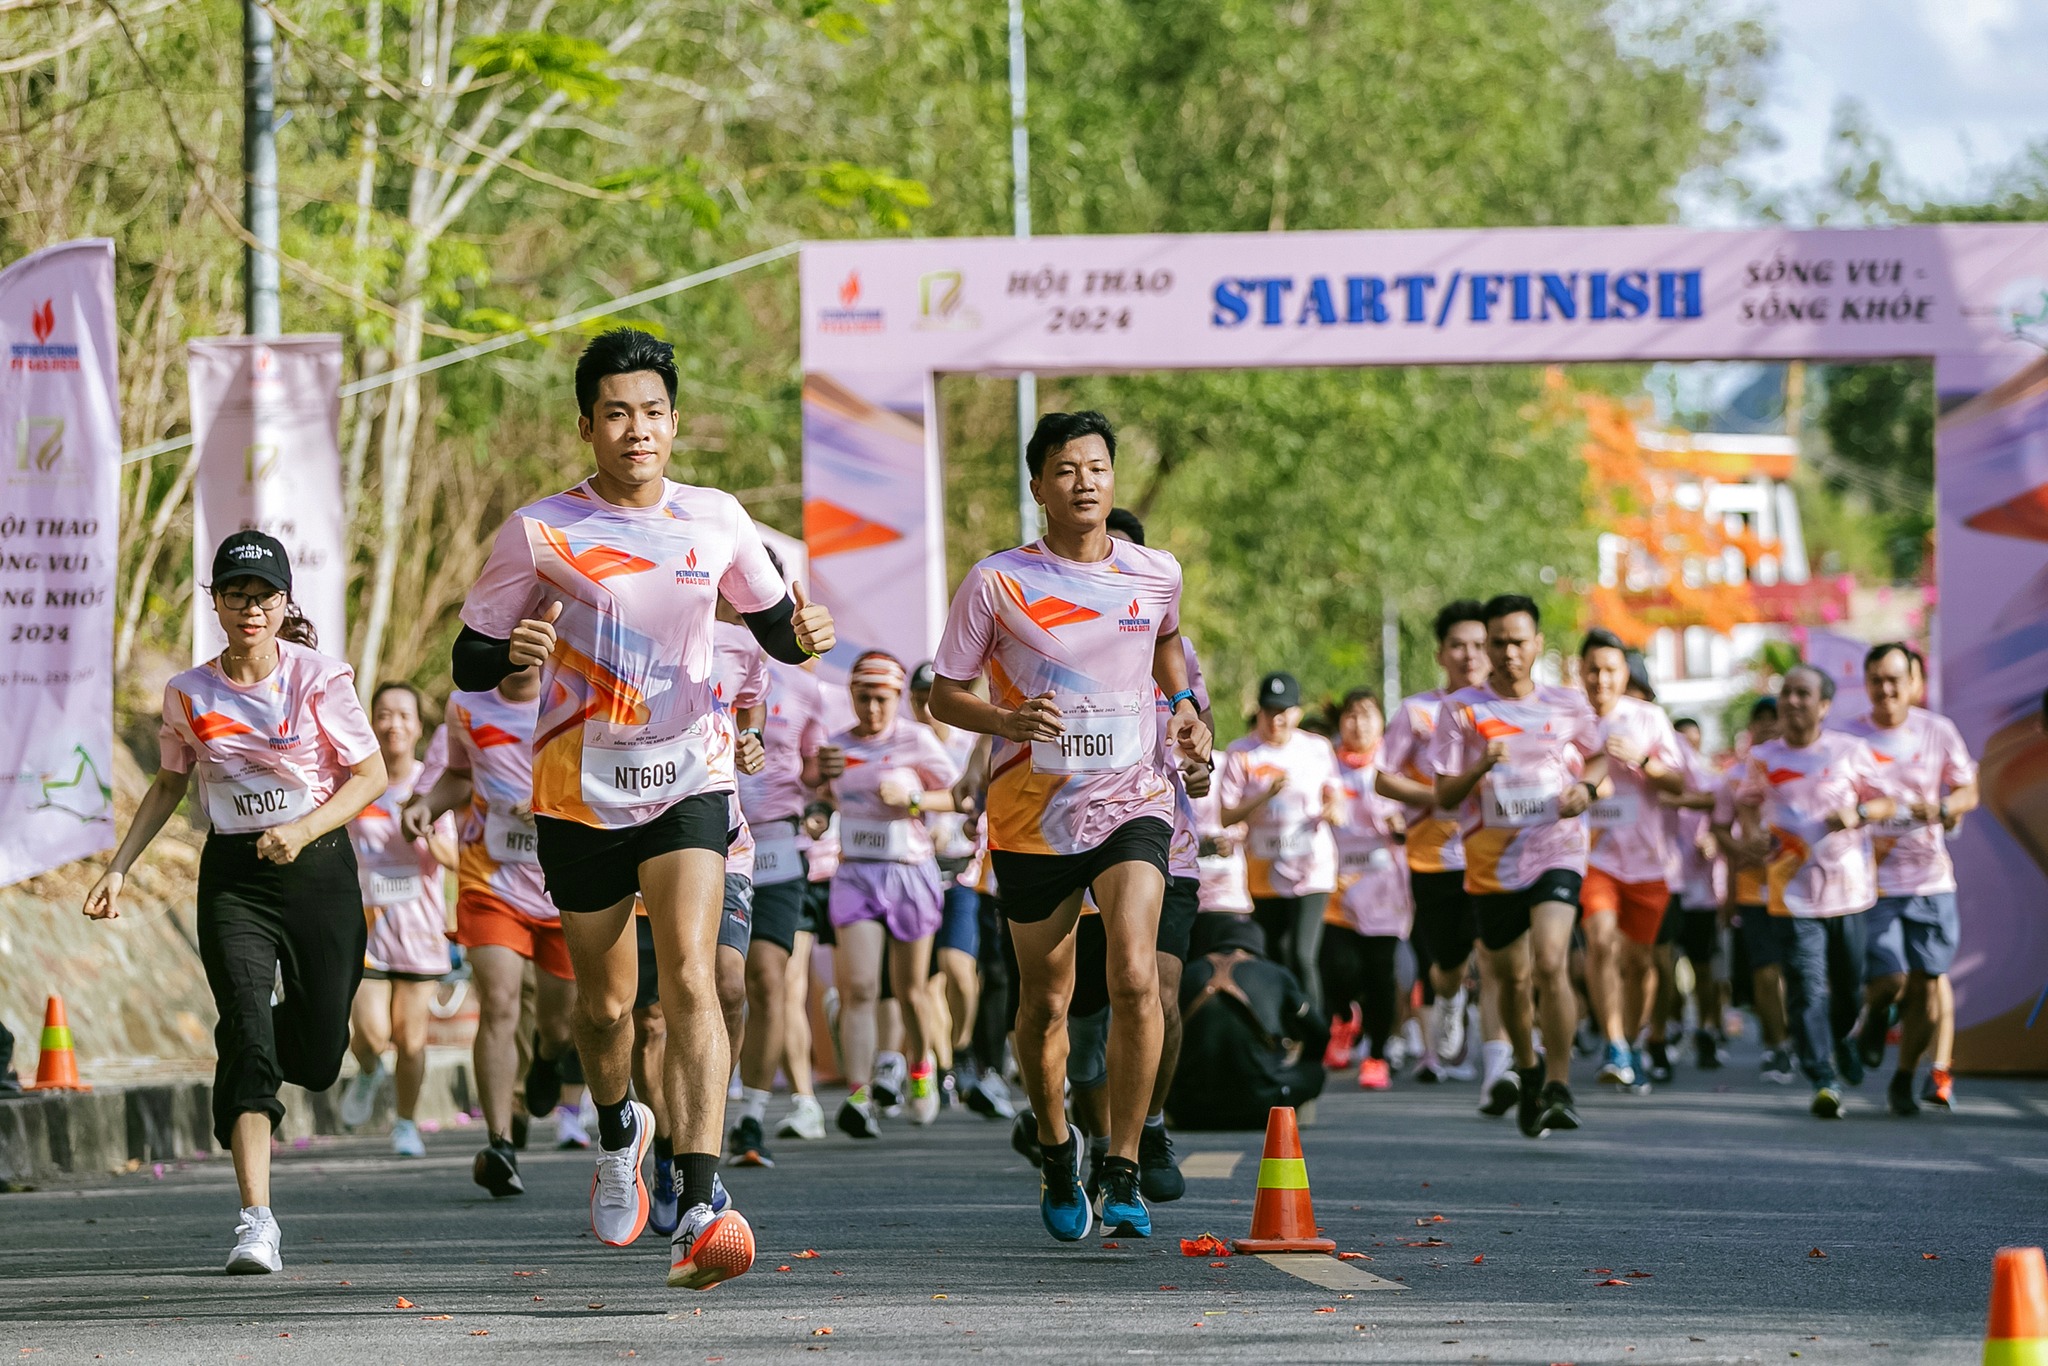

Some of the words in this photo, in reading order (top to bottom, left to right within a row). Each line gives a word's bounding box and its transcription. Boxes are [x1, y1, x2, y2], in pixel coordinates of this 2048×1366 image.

[1846, 258, 1902, 286] VUI
[1211, 268, 1704, 328] START/FINISH
[1047, 306, 1131, 333] 2024
[0, 517, 25, 540] ỘI
[37, 517, 98, 537] THAO
[48, 553, 88, 574] VUI
[10, 623, 70, 643] 2024
[1061, 733, 1113, 757] HT601
[615, 761, 677, 790] NT609
[233, 788, 288, 816] NT302
